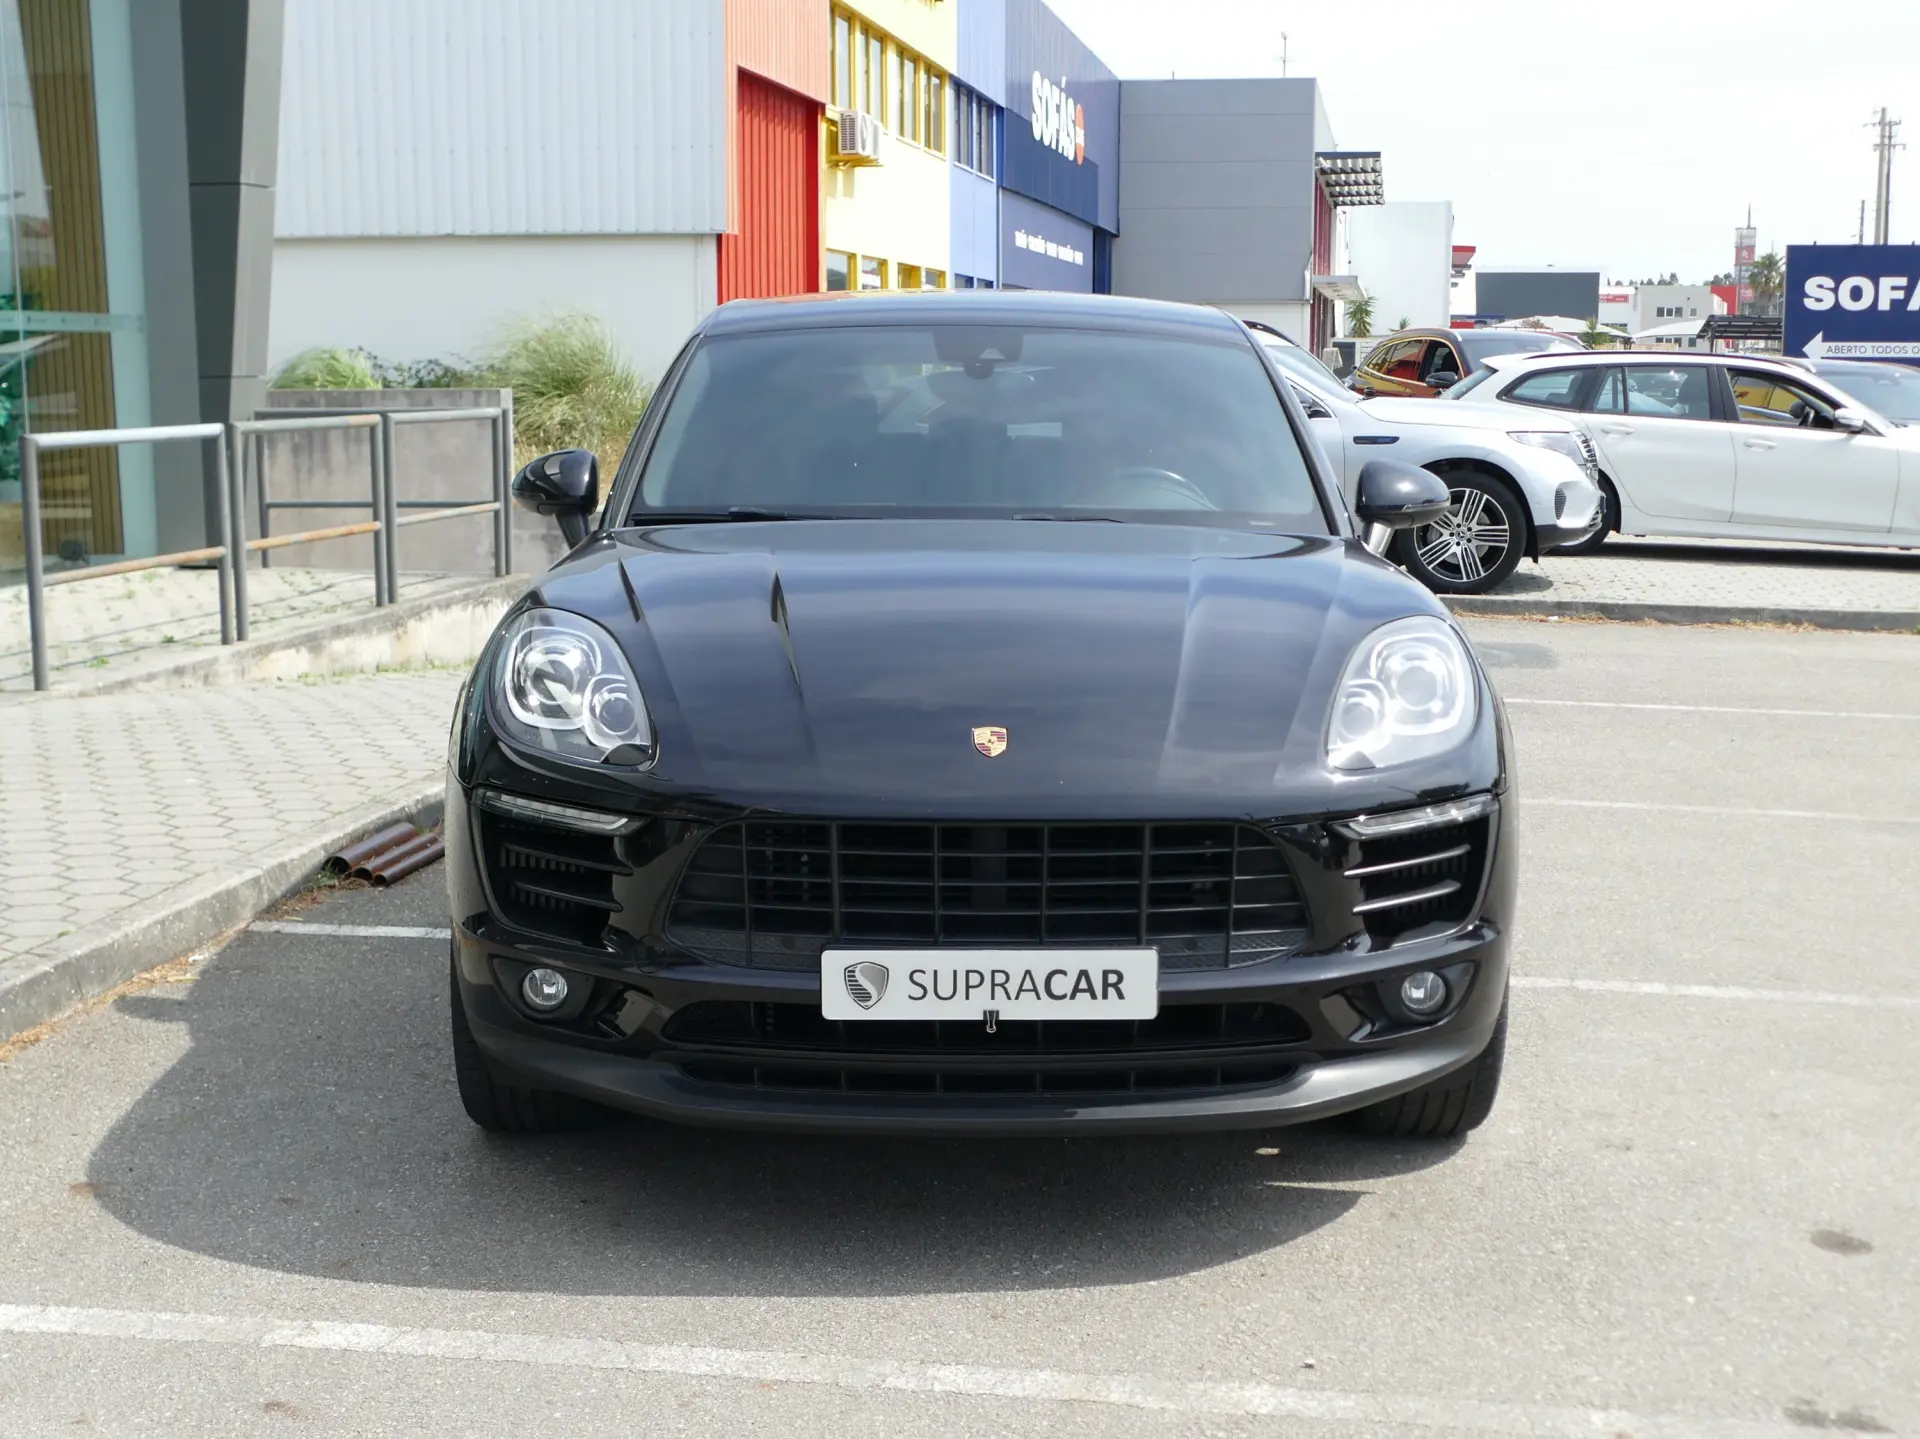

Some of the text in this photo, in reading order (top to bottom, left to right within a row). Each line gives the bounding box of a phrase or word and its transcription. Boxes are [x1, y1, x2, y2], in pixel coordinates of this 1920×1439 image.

[1032, 70, 1075, 161] SOFÁS
[1826, 345, 1867, 354] ABERTO
[1871, 345, 1908, 354] TODOS
[908, 969, 1126, 1001] SUPRACAR
